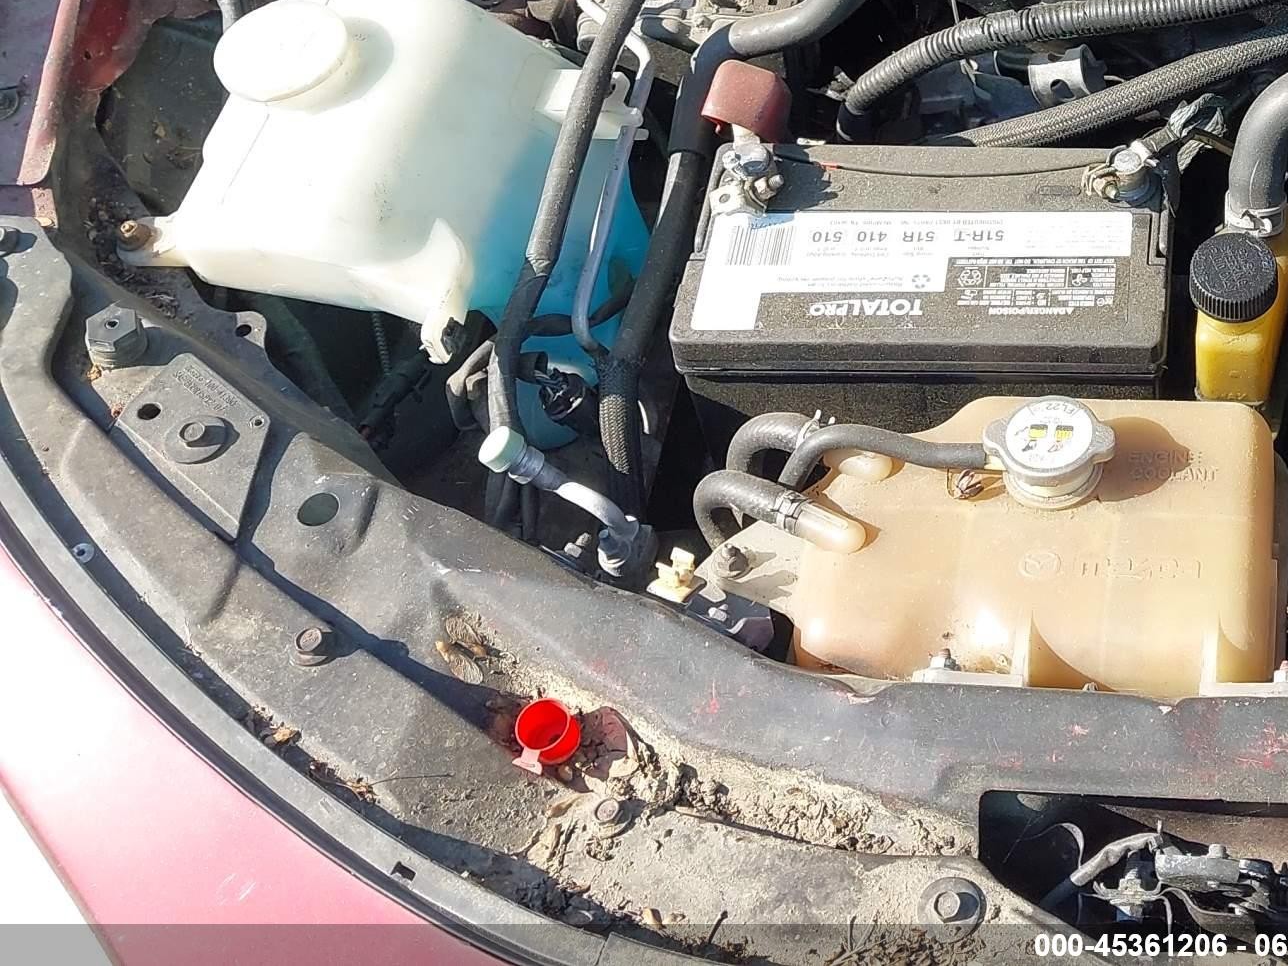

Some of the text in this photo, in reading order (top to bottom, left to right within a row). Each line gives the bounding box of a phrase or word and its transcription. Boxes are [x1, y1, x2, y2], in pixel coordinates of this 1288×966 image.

[812, 229, 1005, 243] 51R-T 51R 410 510
[809, 298, 923, 316] TOTALPRO
[1128, 450, 1203, 465] ENGINE
[1131, 466, 1219, 483] COOLANT
